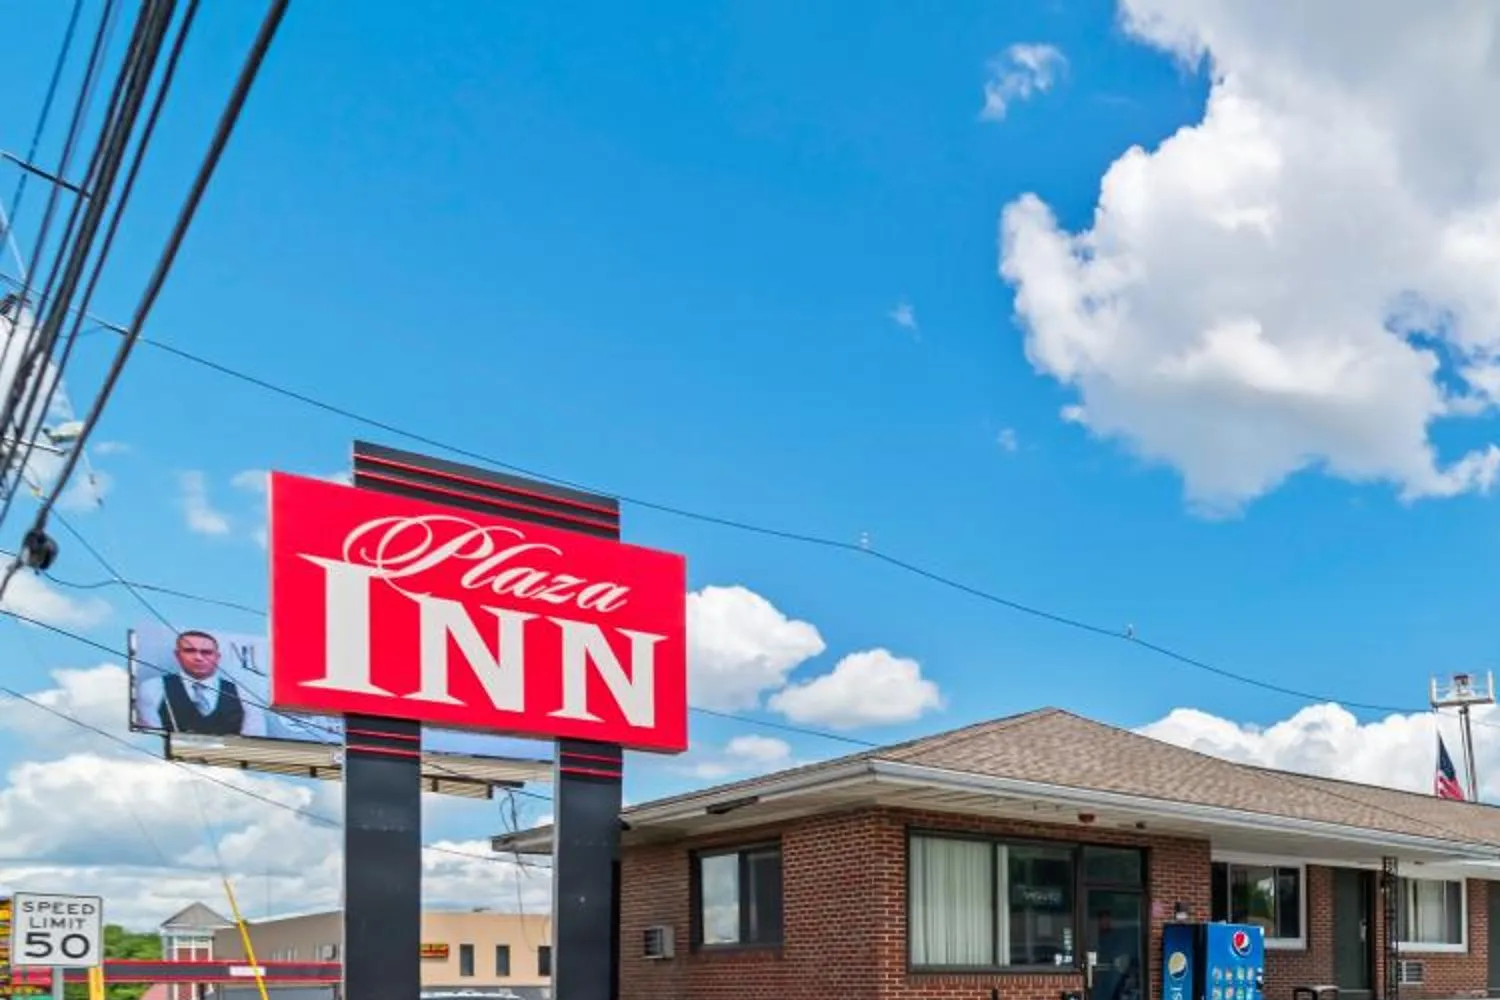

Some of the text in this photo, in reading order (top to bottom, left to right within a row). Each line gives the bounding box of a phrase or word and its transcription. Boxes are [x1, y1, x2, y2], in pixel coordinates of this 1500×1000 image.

[342, 513, 633, 613] Plaza
[296, 552, 669, 729] INN
[22, 901, 96, 915] SPEED
[29, 917, 87, 929] LIMIT
[24, 932, 90, 959] 50
